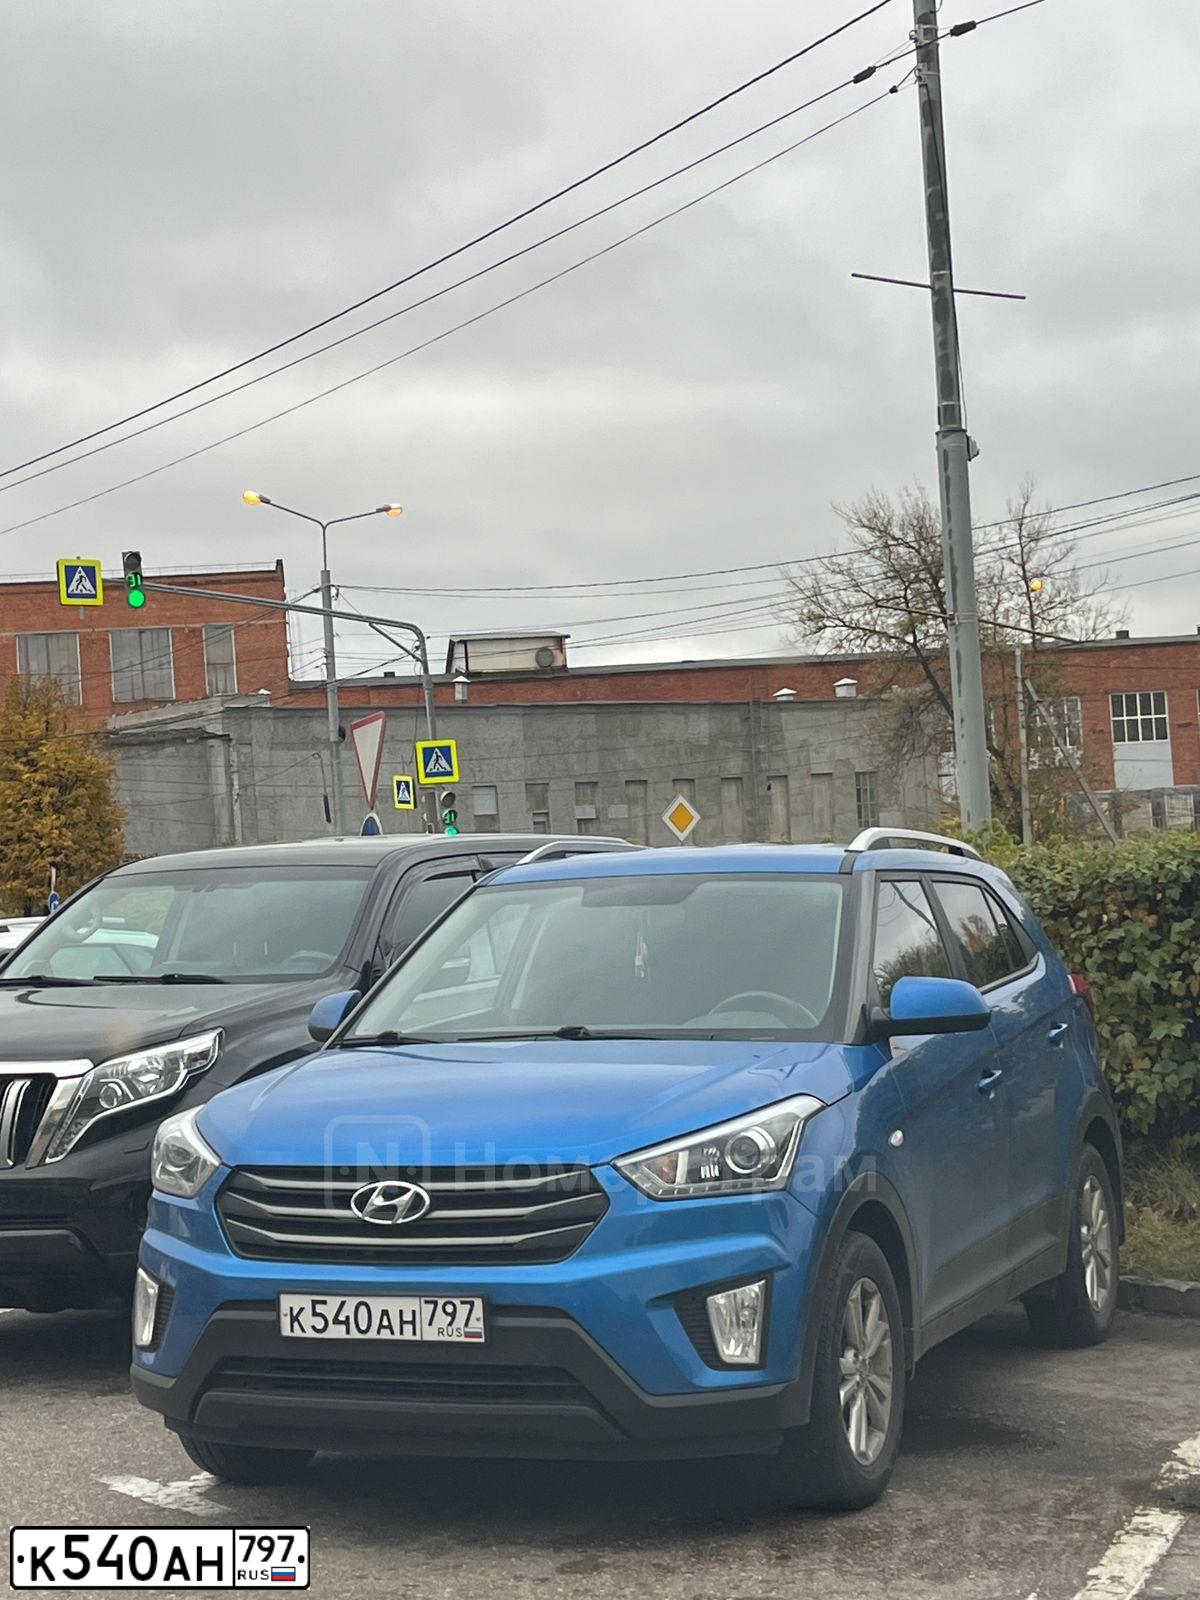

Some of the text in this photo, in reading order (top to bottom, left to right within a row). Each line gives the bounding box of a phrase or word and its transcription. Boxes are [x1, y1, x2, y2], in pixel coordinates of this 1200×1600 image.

[127, 573, 142, 587] 31
[289, 1299, 475, 1336] К540АН 797
[437, 1327, 462, 1338] RUS
